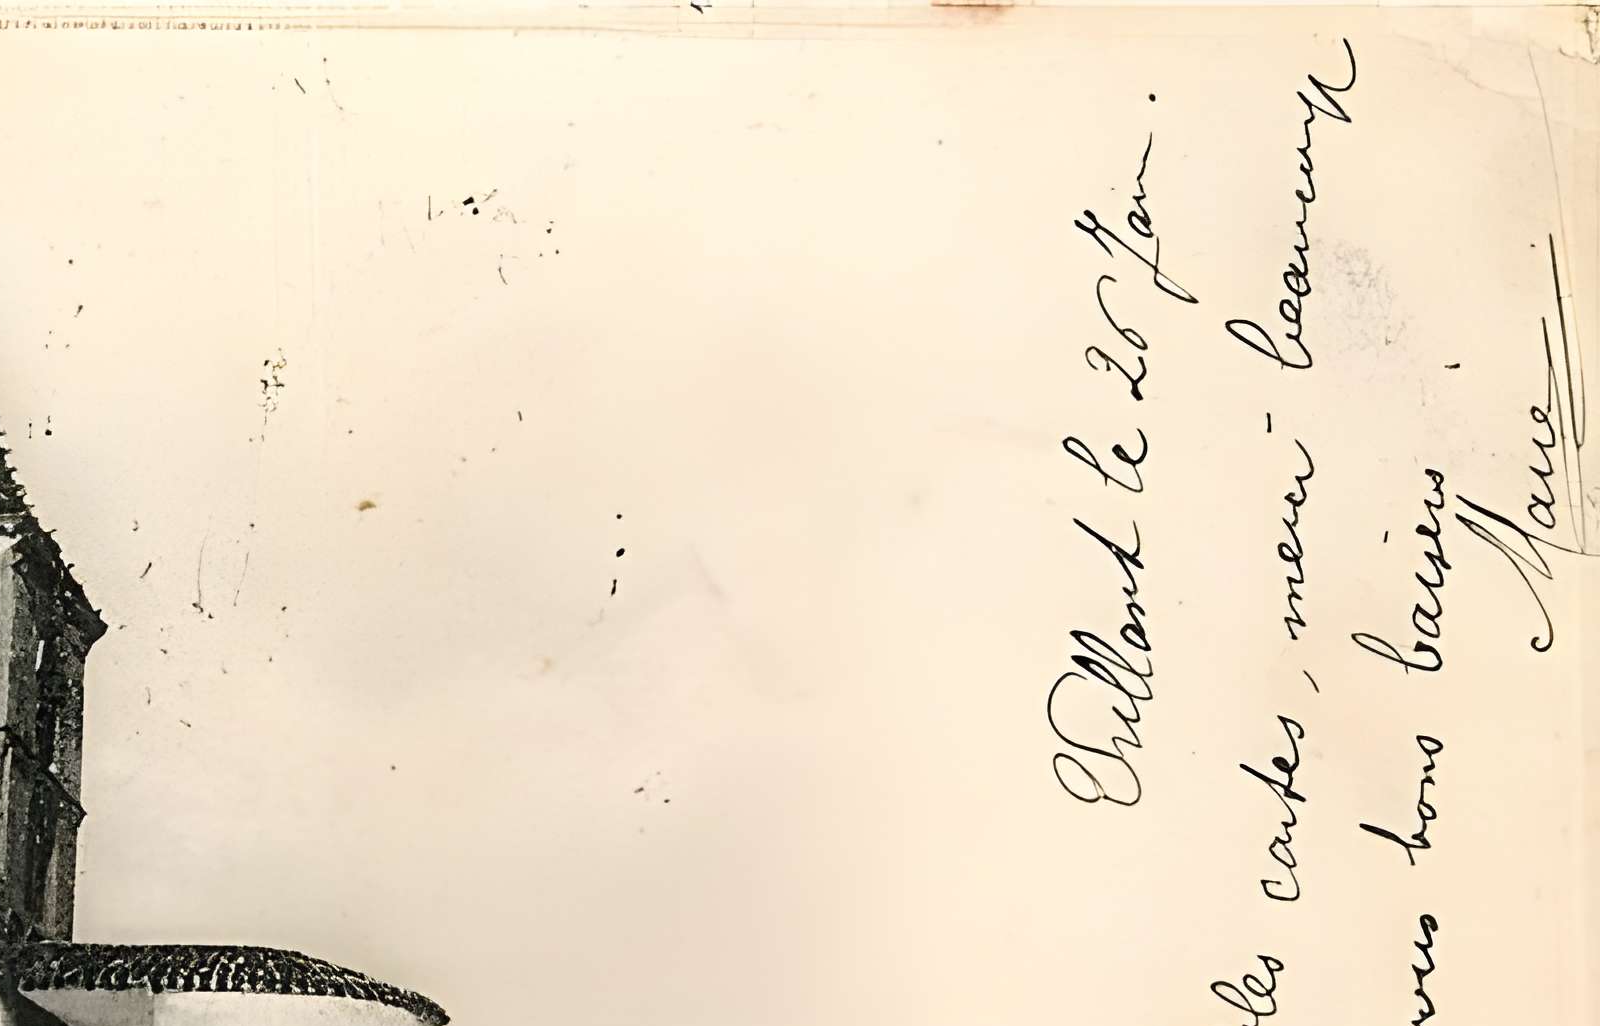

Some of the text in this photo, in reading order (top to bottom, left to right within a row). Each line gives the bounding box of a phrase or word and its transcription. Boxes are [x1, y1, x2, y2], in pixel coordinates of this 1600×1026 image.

[1225, 38, 1356, 369] beaucoup
[1062, 429, 1148, 493] le
[1359, 735, 1443, 866] bons
